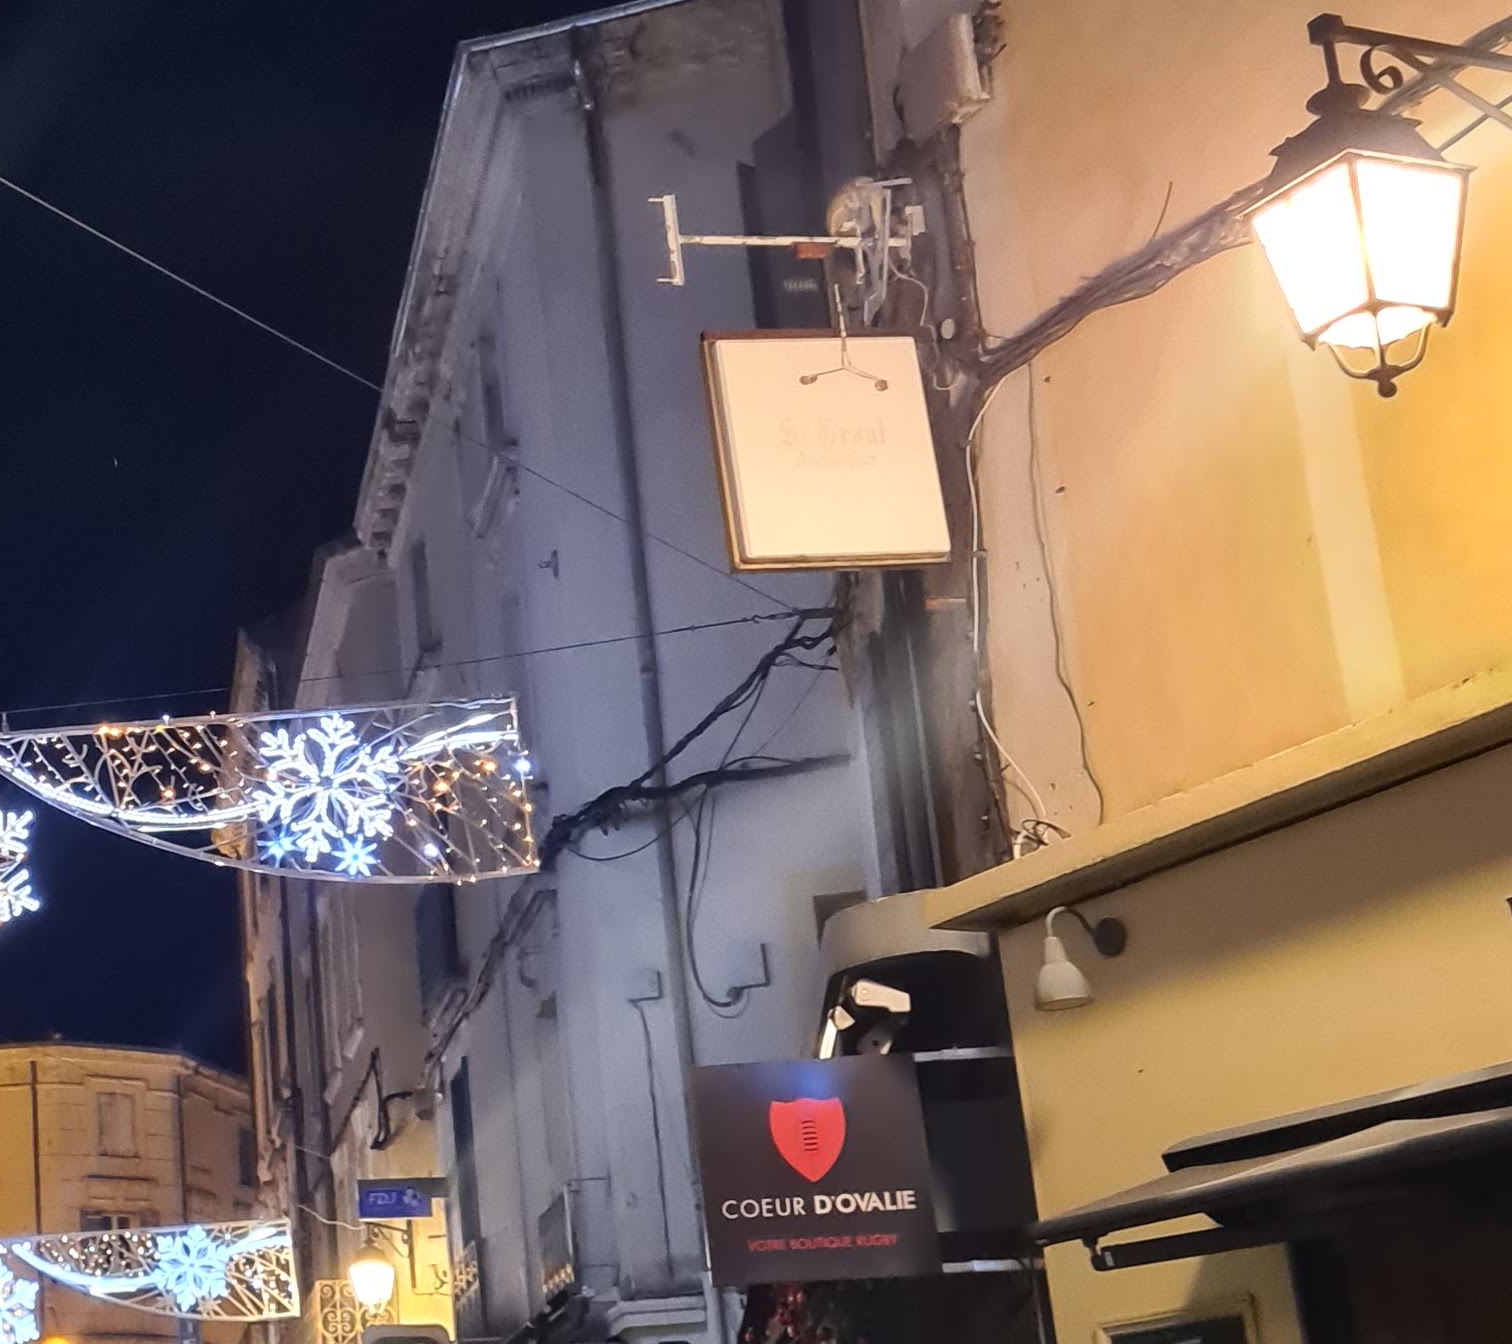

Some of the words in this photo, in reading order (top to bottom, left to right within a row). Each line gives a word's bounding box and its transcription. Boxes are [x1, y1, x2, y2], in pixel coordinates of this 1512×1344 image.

[721, 1196, 807, 1220] COEUR
[813, 1189, 918, 1215] D'OVALIE
[747, 1239, 786, 1252] VOTRE
[789, 1236, 852, 1250] BOUTIQUE
[855, 1234, 898, 1246] RUGBY
